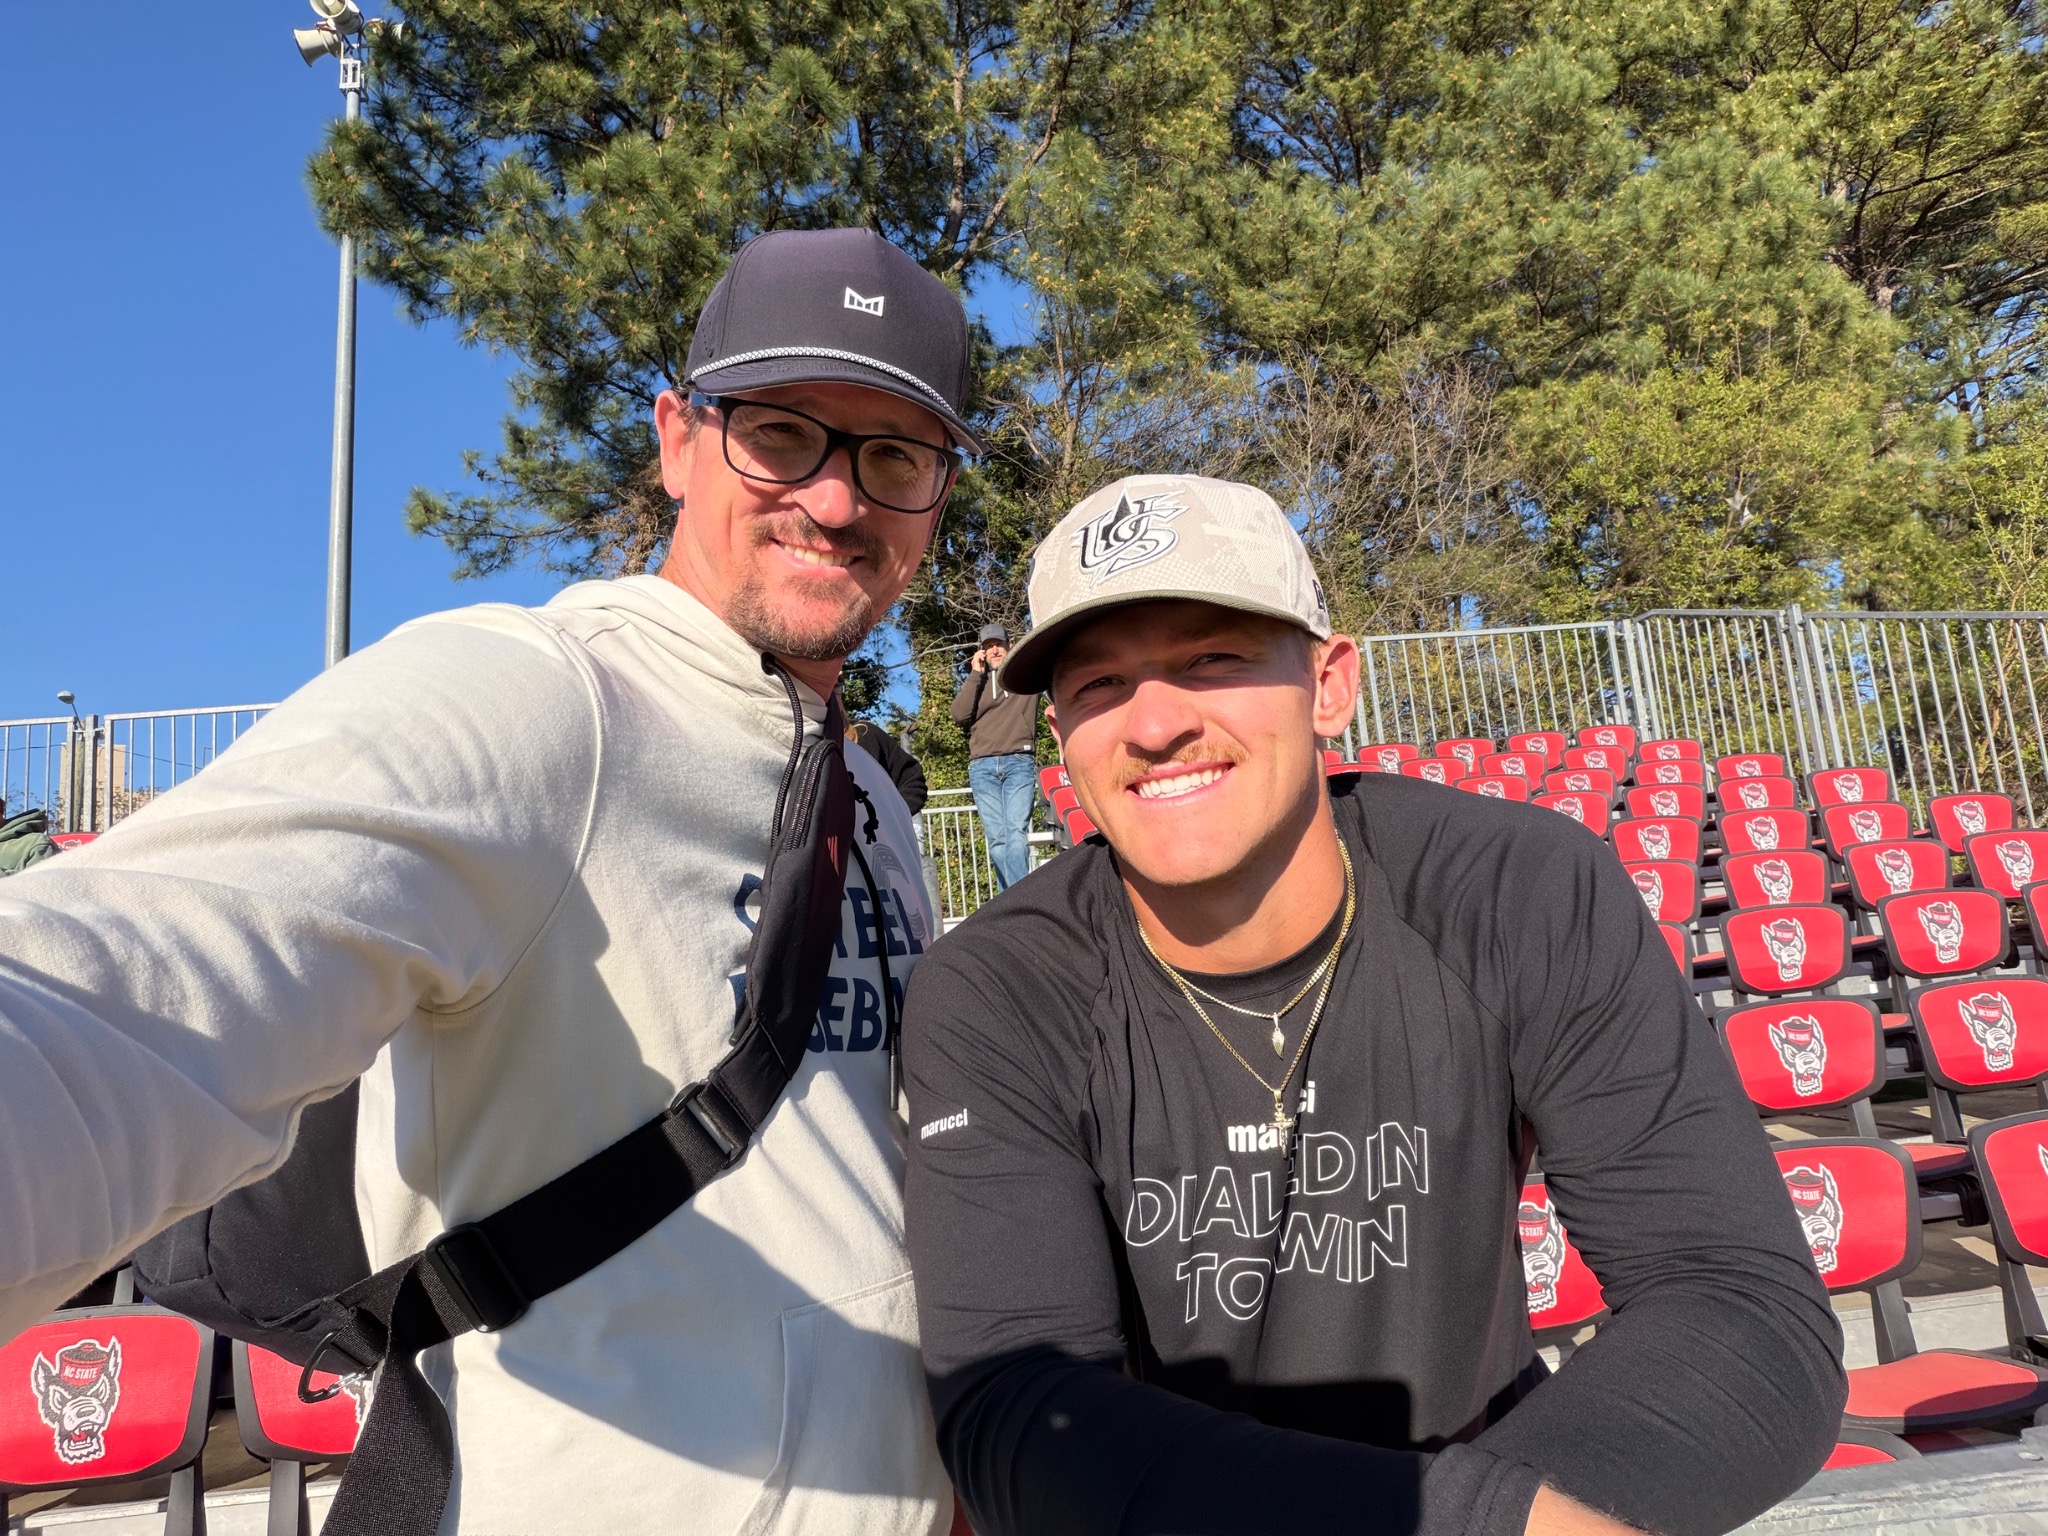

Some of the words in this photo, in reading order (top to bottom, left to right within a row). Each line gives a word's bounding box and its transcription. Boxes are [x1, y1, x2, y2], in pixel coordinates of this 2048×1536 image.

[920, 1108, 969, 1140] marucci
[1366, 1121, 1429, 1201] IN
[1793, 1189, 1802, 1200] NC
[1802, 1190, 1821, 1201] STATE
[1525, 1226, 1543, 1236] STATE
[1176, 1253, 1272, 1324] TO
[1273, 1204, 1407, 1283] WIN
[64, 1365, 75, 1378] NC
[75, 1367, 98, 1379] STATE
